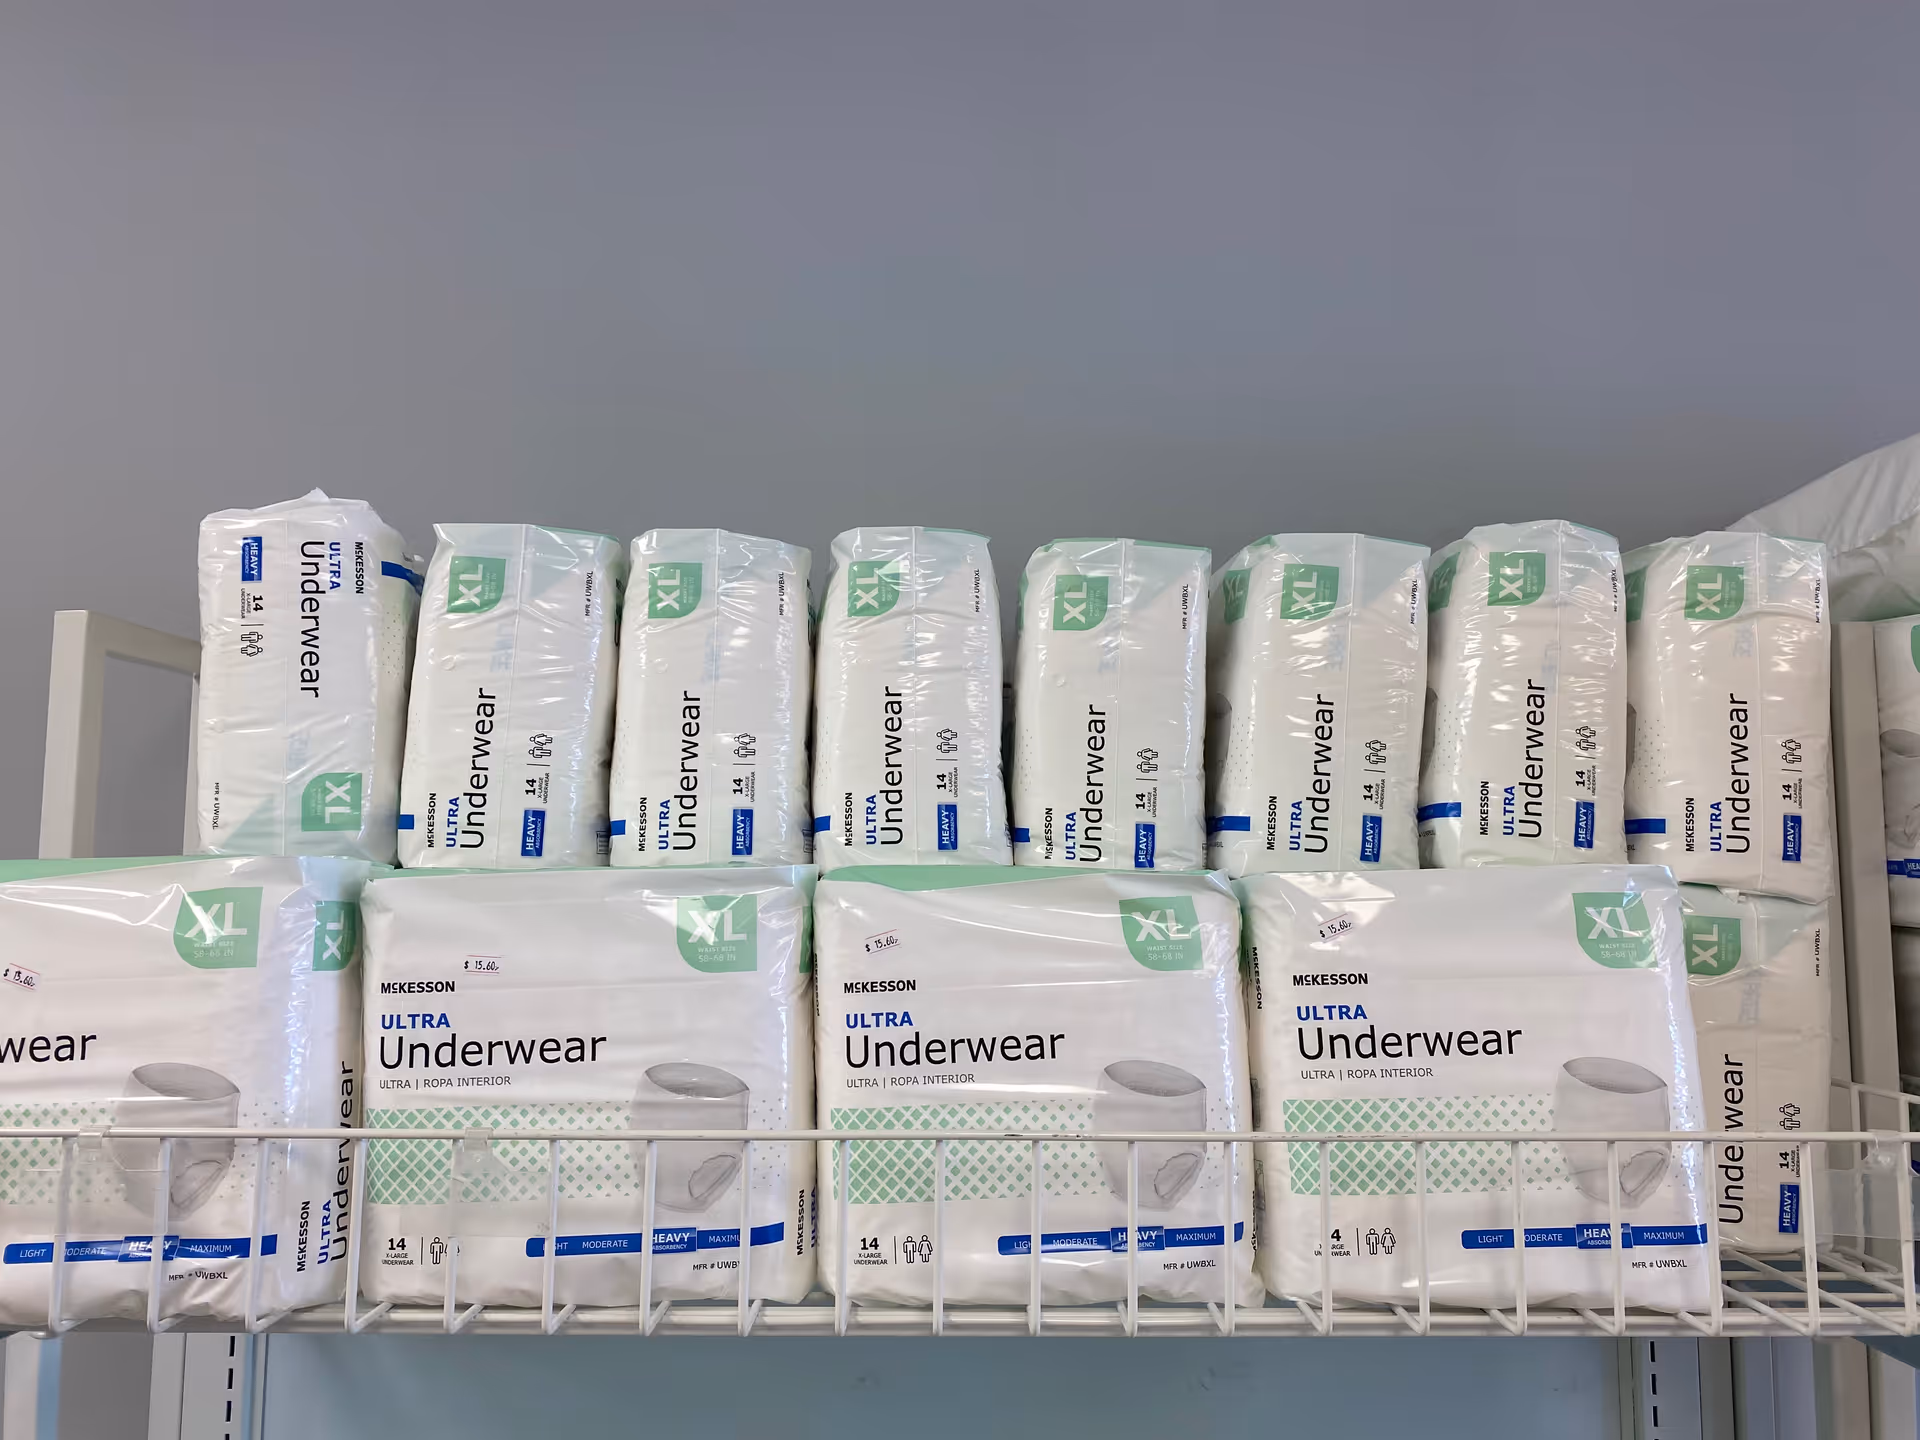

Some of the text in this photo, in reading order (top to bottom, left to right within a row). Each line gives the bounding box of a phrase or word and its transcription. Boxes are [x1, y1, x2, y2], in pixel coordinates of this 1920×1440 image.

[250, 542, 258, 575] HEAVY
[329, 542, 341, 590] ULTRA
[458, 564, 483, 607] XL
[586, 571, 594, 597] UWBXL
[656, 569, 680, 611] XL
[856, 568, 879, 609] XL
[1291, 572, 1317, 613] XL
[1499, 559, 1524, 600] XL
[1695, 573, 1722, 613] XL
[253, 595, 264, 612] 14
[300, 541, 326, 698] Underwear
[1063, 582, 1087, 624] XL
[460, 687, 496, 849] Underwear
[673, 691, 700, 850] Underwear
[879, 686, 903, 845] Underwear
[1304, 694, 1334, 853] Underwear
[1518, 679, 1545, 838] Underwear
[1725, 693, 1750, 854] Underwear
[525, 778, 536, 795] 14
[732, 778, 743, 795] 14
[936, 773, 946, 790] 14
[1079, 704, 1106, 862] Underwear
[1363, 784, 1373, 801] 14
[1575, 770, 1585, 787] 14
[1782, 783, 1791, 800] 14
[325, 780, 351, 824] XL
[1135, 792, 1145, 810] 14
[1502, 785, 1516, 835] ULTRA
[445, 796, 459, 847] ULTRA
[525, 816, 536, 850] HEAVY
[658, 799, 670, 850] ULTRA
[736, 815, 745, 849] HEAVY
[866, 794, 877, 845] ULTRA
[1065, 811, 1077, 860] ULTRA
[1289, 800, 1302, 851] ULTRA
[1578, 807, 1587, 841] HEAVY
[1710, 801, 1722, 852] ULTRA
[1138, 829, 1147, 862] HEAVY
[1365, 821, 1375, 856] HEAVY
[1786, 820, 1794, 855] HEAVY
[323, 909, 344, 961] XL
[688, 909, 747, 945] XL
[1130, 908, 1192, 942] XL
[1319, 929, 1325, 938] $
[1584, 906, 1644, 940] XL
[698, 953, 736, 963] 58-68 IN
[1147, 952, 1184, 961] 58-68 IN
[1600, 950, 1626, 958] 58-68
[1691, 924, 1719, 968] XL
[464, 960, 469, 970] $
[381, 1012, 451, 1030] ULTRA
[845, 1011, 914, 1029] ULTRA
[1296, 1004, 1368, 1021] ULTRA
[380, 1033, 607, 1070] Underwear
[845, 1031, 1065, 1069] Underwear
[1297, 1024, 1522, 1060] Underwear
[379, 1075, 511, 1090] ULTRA ROPA INTERIOR
[846, 1073, 975, 1088] ULTRA ROPA INTERIOR
[1300, 1067, 1433, 1080] ULTRA ROPA INTERIOR
[1718, 1054, 1744, 1223] Undewear
[1779, 1151, 1789, 1169] 14
[1783, 1190, 1791, 1226] HEAVY
[317, 1199, 331, 1264] ULTRA
[388, 1237, 406, 1251] 14
[582, 1232, 690, 1249] MODERATE HEAVY
[860, 1237, 879, 1250] 14
[1052, 1237, 1098, 1247] MODERATE
[1118, 1231, 1157, 1241] HAVY
[1176, 1232, 1216, 1241] MAXIMUM
[1478, 1231, 1684, 1243] LIGHT ODERATE MAXIMUM
[19, 1240, 232, 1258] LIGHT ODERATE HEAY MAXIMUM
[692, 1263, 708, 1271] MFR
[716, 1261, 740, 1269] UWB
[1186, 1260, 1216, 1269] UWBXL
[1631, 1261, 1647, 1269] MFR
[1655, 1259, 1688, 1268] UWBXL
[195, 1271, 228, 1280] UWBXL
